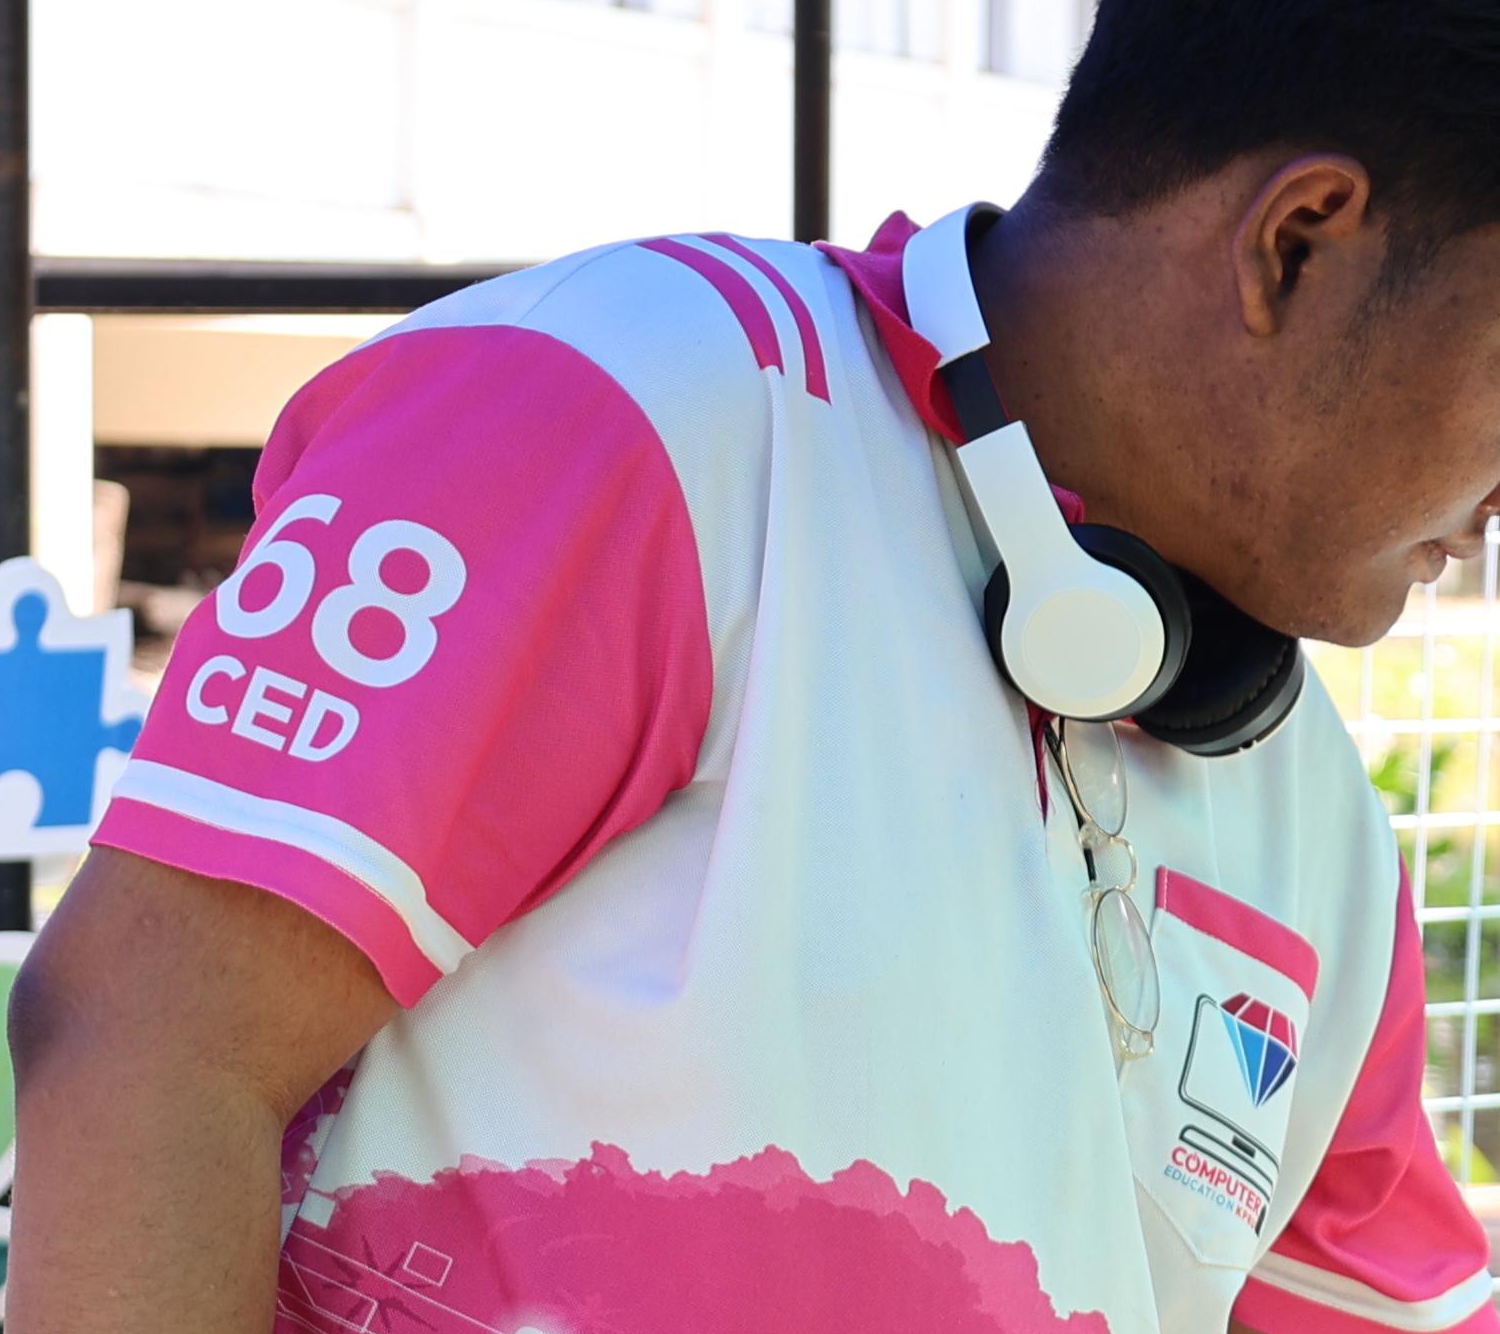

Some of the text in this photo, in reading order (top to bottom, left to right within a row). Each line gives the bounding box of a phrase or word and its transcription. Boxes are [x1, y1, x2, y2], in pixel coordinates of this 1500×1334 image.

[215, 493, 466, 688] 68
[185, 654, 360, 762] CED
[1164, 1165, 1234, 1211] EDUCATION
[1171, 1146, 1262, 1215] COMPUTER
